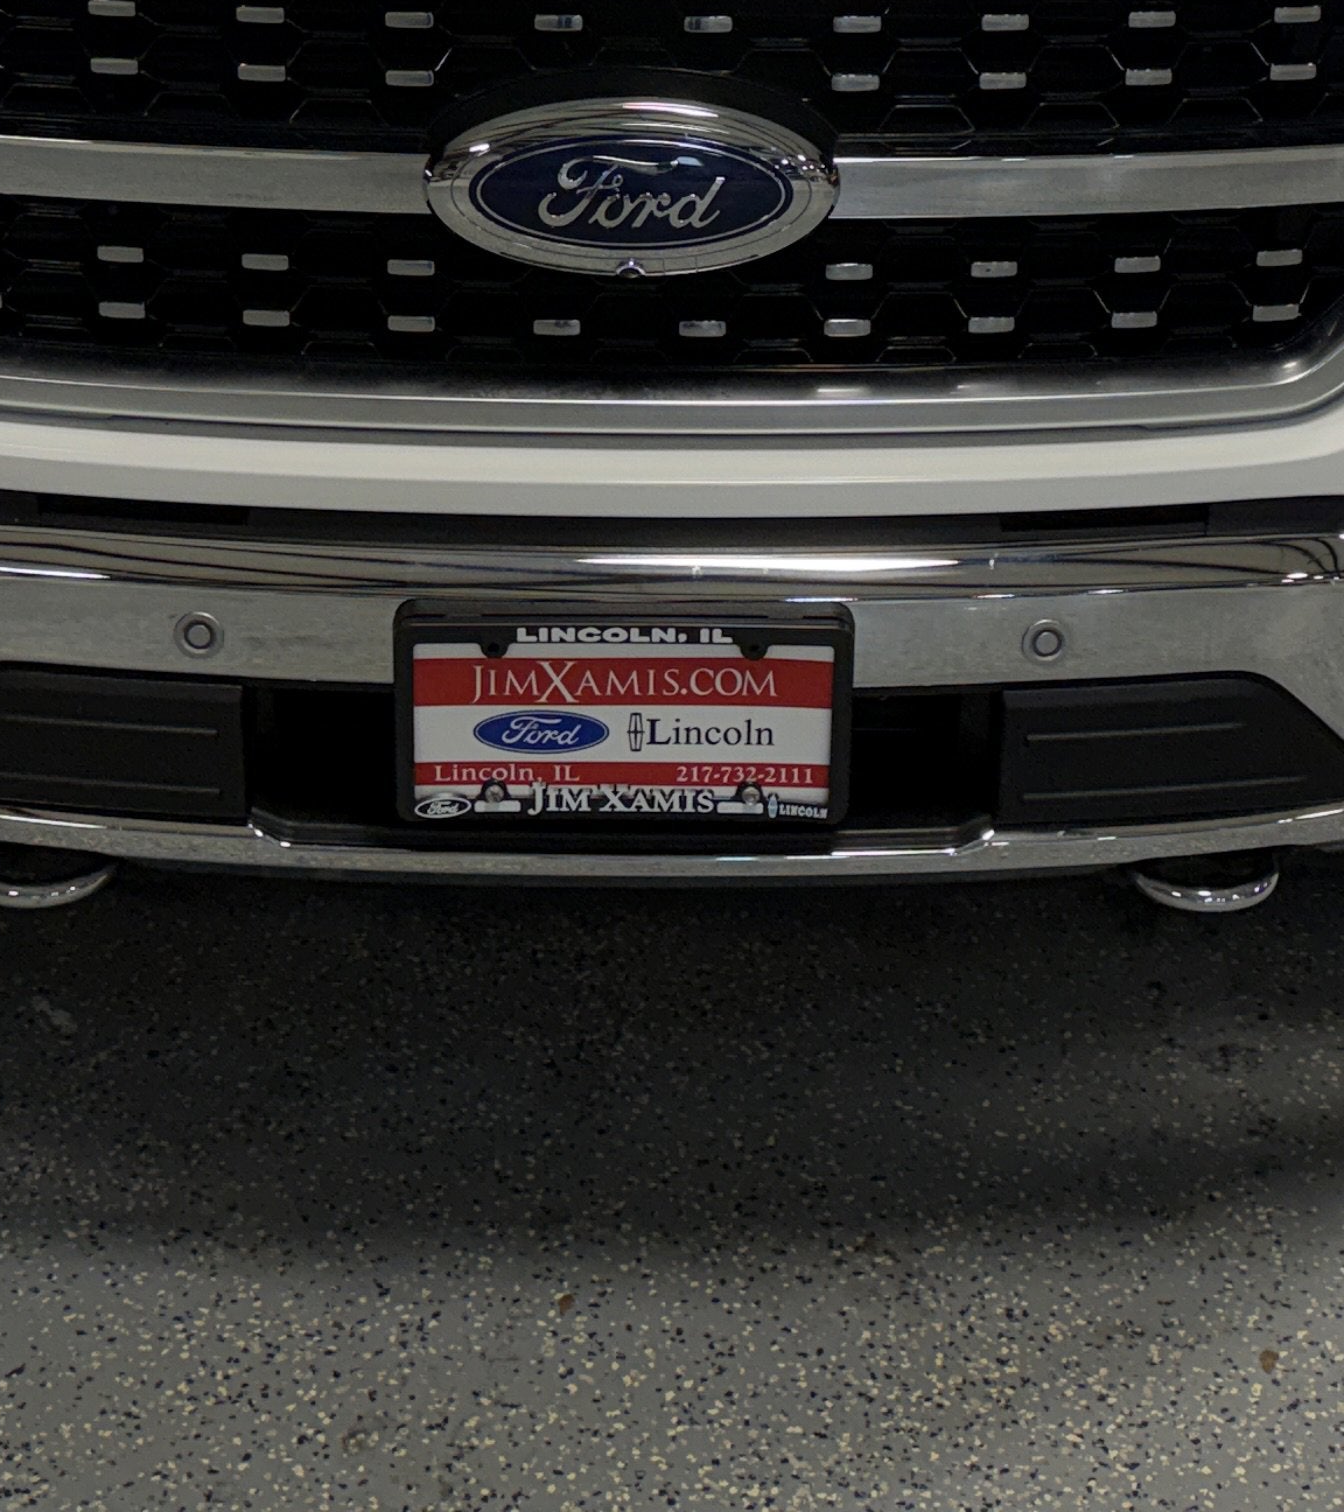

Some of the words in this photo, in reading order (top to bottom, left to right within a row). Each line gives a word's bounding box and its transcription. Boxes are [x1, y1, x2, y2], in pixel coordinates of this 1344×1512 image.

[537, 155, 727, 230] Ford
[516, 627, 687, 644] LINCOLN,
[700, 628, 734, 644] IL
[500, 715, 579, 746] Ford
[646, 718, 775, 747] Lincoln
[434, 764, 543, 783] Lincoln,
[554, 765, 580, 782] IL
[676, 766, 814, 784] 217-732-2111
[427, 800, 460, 816] Ford
[527, 784, 592, 816] JIM
[599, 788, 716, 814] XAMIS
[779, 804, 828, 819] LINCOLN
